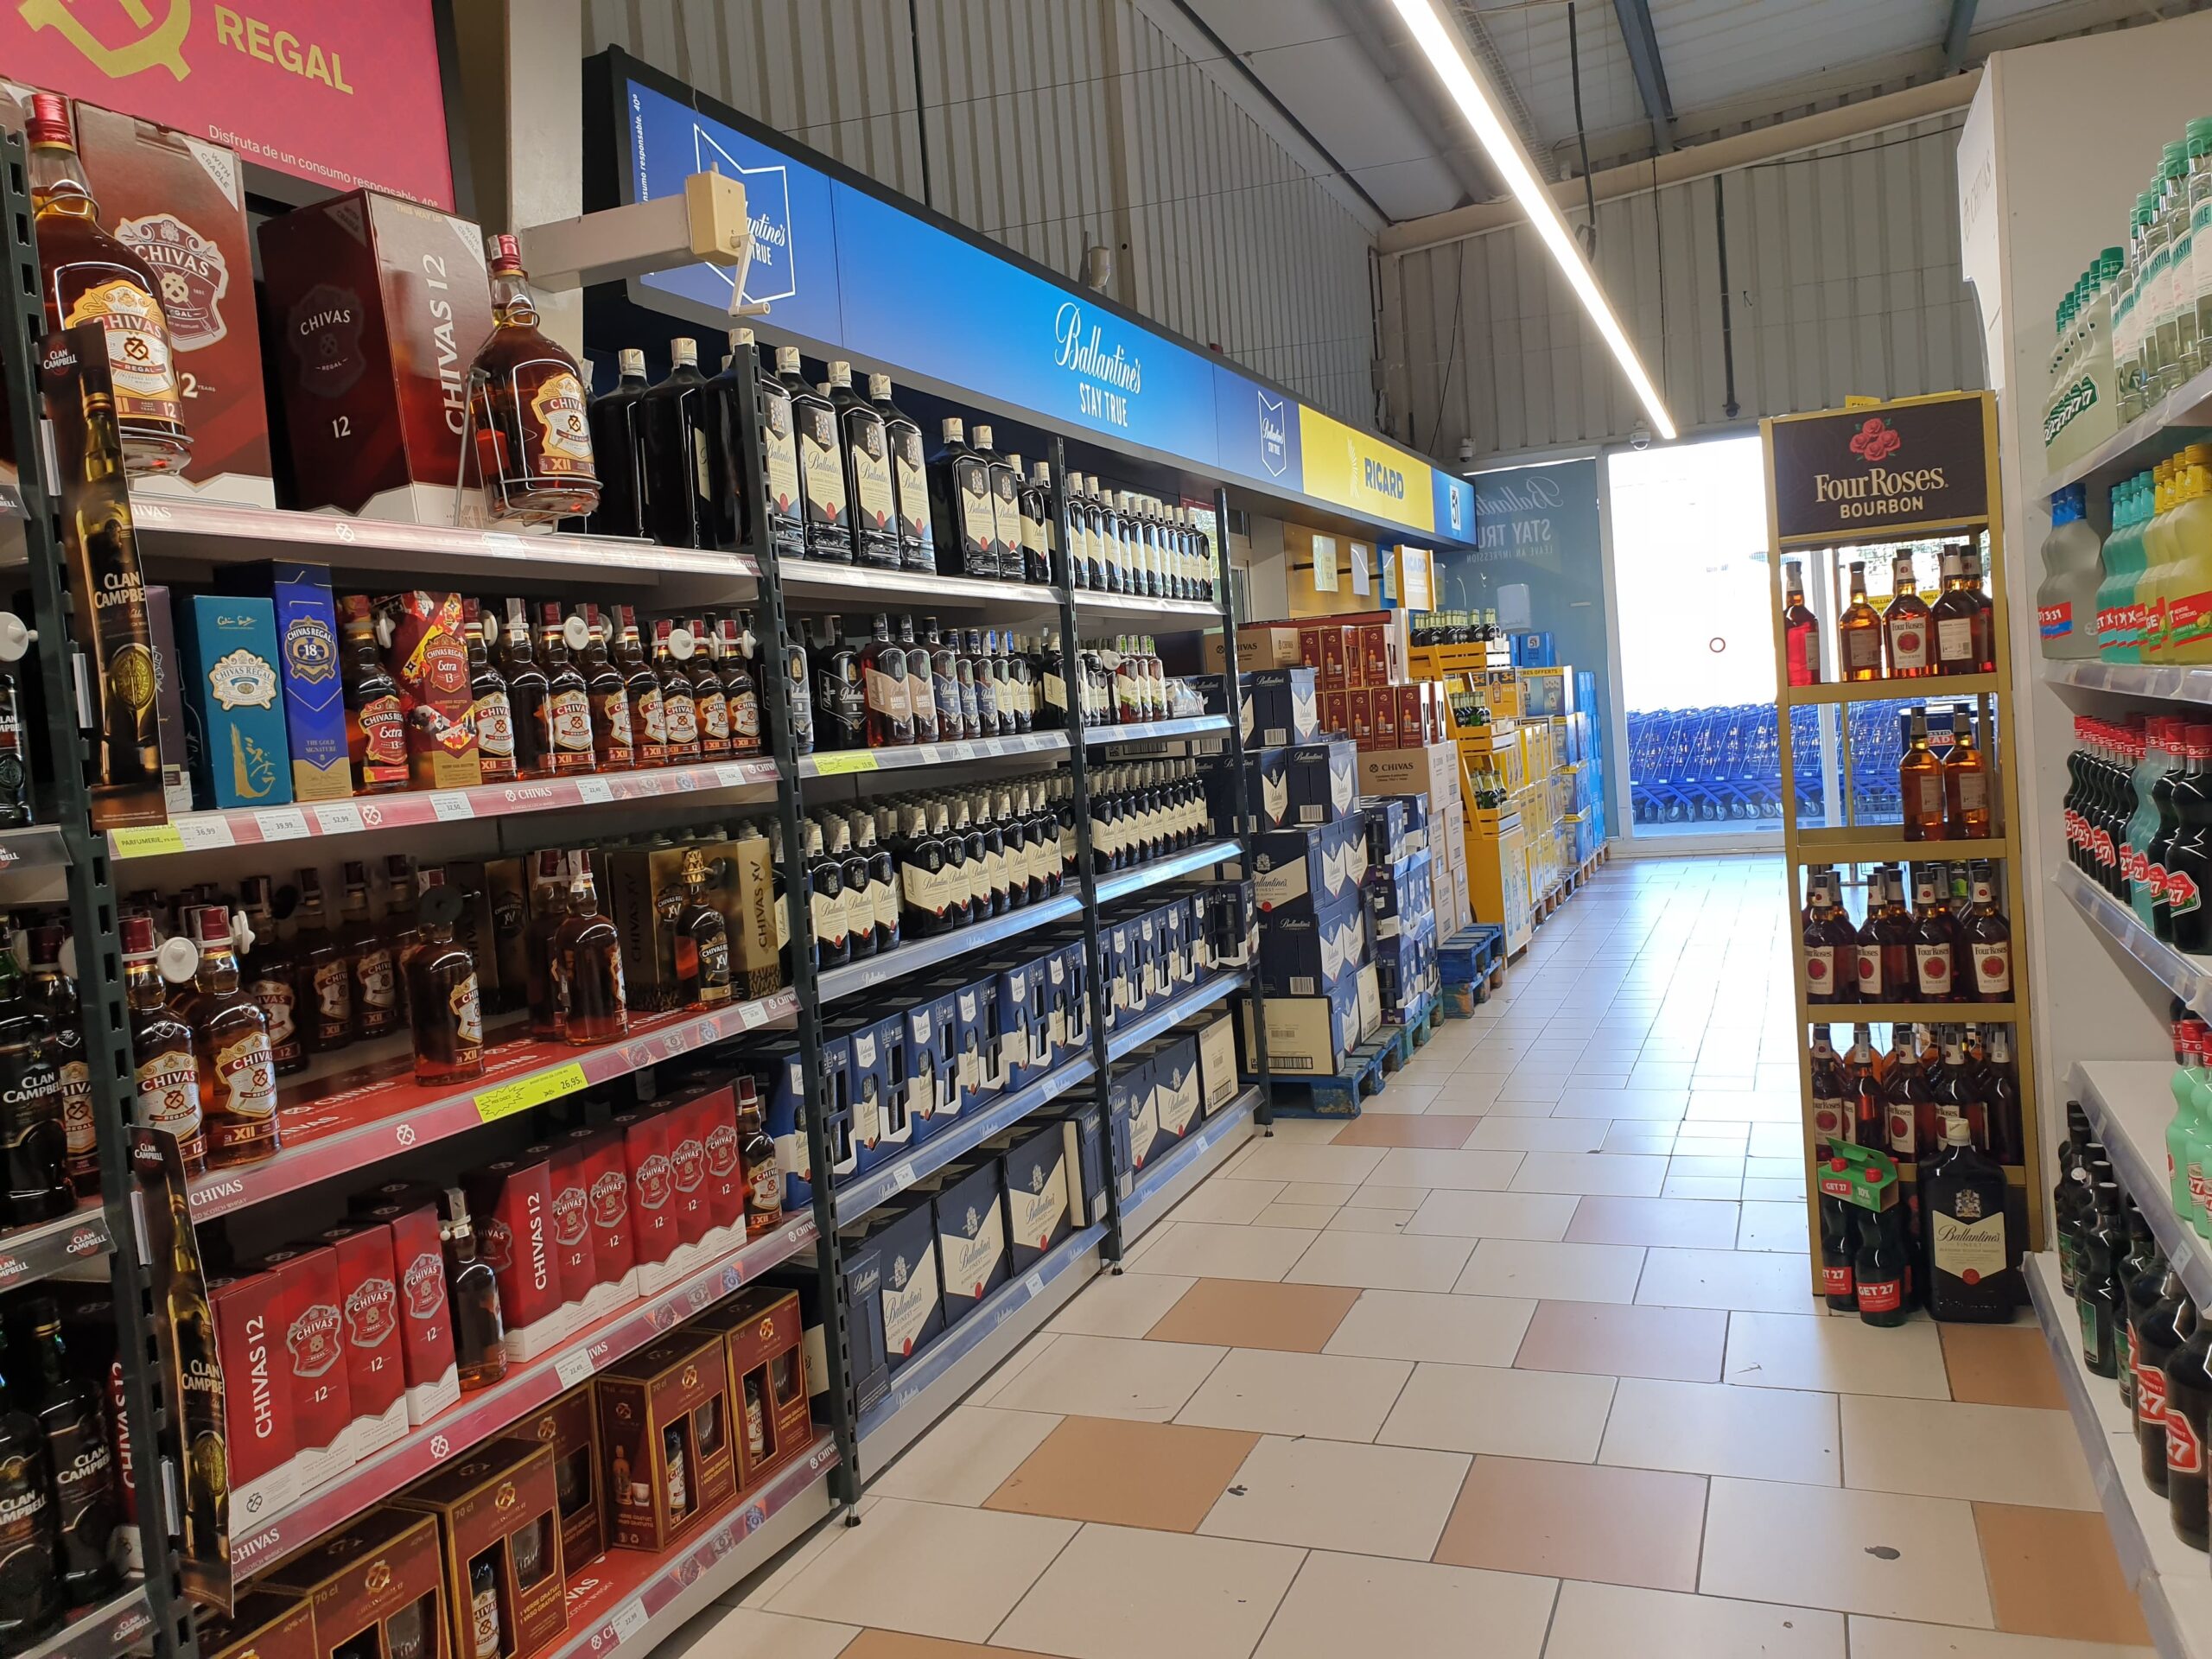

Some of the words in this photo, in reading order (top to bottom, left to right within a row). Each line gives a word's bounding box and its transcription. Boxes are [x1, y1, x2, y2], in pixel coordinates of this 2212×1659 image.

[214, 3, 353, 95] REGAL
[208, 124, 260, 153] Disfruta
[262, 144, 278, 159] de
[281, 151, 296, 166] un
[298, 158, 351, 184] consumo
[200, 152, 230, 188] CRADLE
[211, 151, 232, 178] WITH
[134, 245, 210, 277] CHIVAS
[423, 254, 448, 291] 12
[300, 309, 351, 336] CHIVAS
[49, 349, 68, 359] CLAN
[1054, 302, 1141, 395] Ballantine's
[43, 353, 78, 370] CAMPBELL
[124, 364, 156, 373] REGAL
[429, 298, 467, 435] CHIVAS
[162, 402, 176, 418] 12
[1079, 382, 1104, 416] STAY
[1104, 391, 1128, 428] TRUE
[332, 416, 351, 439] 12
[551, 458, 572, 470] XII
[1364, 457, 1404, 500] RICARD
[1814, 473, 1869, 503] Four
[1869, 467, 1949, 498] Roses
[1451, 501, 1460, 525] 51
[1840, 495, 1924, 519] BOURBON
[104, 570, 142, 590] CLAN
[94, 588, 146, 609] CAMPBE
[287, 626, 310, 641] CHIVAS
[310, 626, 333, 643] REGAL
[304, 644, 317, 657] 18
[427, 648, 446, 659] CHIVAS
[446, 649, 465, 659] REGAL
[438, 660, 458, 671] Extra
[215, 667, 245, 683] CHIVAS
[246, 667, 273, 682] REGAL
[445, 673, 454, 683] 13
[1255, 676, 1285, 685] Ballantine's
[363, 713, 392, 727] CHIVAS
[392, 712, 404, 721] REG
[379, 727, 403, 739] Extra
[391, 741, 399, 750] 13
[557, 754, 572, 765] XII
[616, 749, 628, 759] XII
[1294, 751, 1324, 762] Ballantine's
[480, 760, 497, 771] XII
[1382, 762, 1414, 772] CHIVAS
[518, 787, 552, 800] CHIVAS
[195, 827, 216, 836] 36,99
[275, 821, 294, 830] 39,99
[750, 861, 762, 882] XV
[1254, 875, 1287, 888] allantine's
[2169, 888, 2184, 903] 27
[755, 887, 768, 949] CHIVAS
[1280, 918, 1311, 929] Ballantine's
[702, 944, 723, 957] CHIVAS
[715, 953, 728, 966] XV
[463, 1050, 478, 1061] XII
[22, 1071, 55, 1089] CLAN
[141, 1071, 196, 1092] CHIVAS
[3, 1080, 62, 1104] CAMPBEL
[164, 1111, 188, 1122] REGAL
[234, 1126, 256, 1141] XII
[140, 1142, 156, 1152] CLAN
[192, 1142, 203, 1154] 12
[709, 1135, 734, 1149] CHIVAS
[135, 1149, 163, 1161] CAMPBELL
[676, 1150, 699, 1165] CHIVAS
[642, 1166, 665, 1181] CHIVAS
[190, 1179, 244, 1206] CHIVAS
[596, 1182, 622, 1198] CHIVAS
[721, 1183, 731, 1195] 12
[1826, 1182, 1838, 1192] GET
[527, 1192, 540, 1211] 12
[557, 1198, 582, 1215] CHIVAS
[688, 1198, 697, 1211] 12
[655, 1217, 664, 1228] 12
[756, 1215, 769, 1225] XII
[73, 1231, 95, 1244] CLAN
[609, 1235, 620, 1248] 12
[1936, 1224, 2001, 1246] Ballantine's
[67, 1234, 107, 1254] CAMPBELL
[530, 1211, 547, 1290] CHIVAS
[571, 1253, 582, 1266] 12
[410, 1265, 437, 1286] CHIVAS
[1832, 1269, 1844, 1280] 27
[1859, 1285, 1877, 1296] GET
[1878, 1284, 1894, 1295] 27
[353, 1291, 388, 1312] CHIVAS
[886, 1287, 923, 1327] Ballantine's
[246, 1314, 264, 1338] 12
[296, 1318, 334, 1341] CHIVAS
[426, 1326, 437, 1341] 12
[588, 1341, 608, 1359] IVAS
[190, 1359, 221, 1377] CLAN
[371, 1356, 384, 1372] 12
[181, 1373, 224, 1395] CAMPBE
[249, 1346, 273, 1438] CHIVAS
[314, 1386, 328, 1402] 12
[2138, 1384, 2165, 1414] 27
[74, 1444, 107, 1468] CLAN
[0, 1490, 36, 1511] CLAN
[231, 1528, 280, 1565] CHIVAS
[113, 1615, 152, 1641] CAMPBELL
[119, 1614, 141, 1628] CLAN
